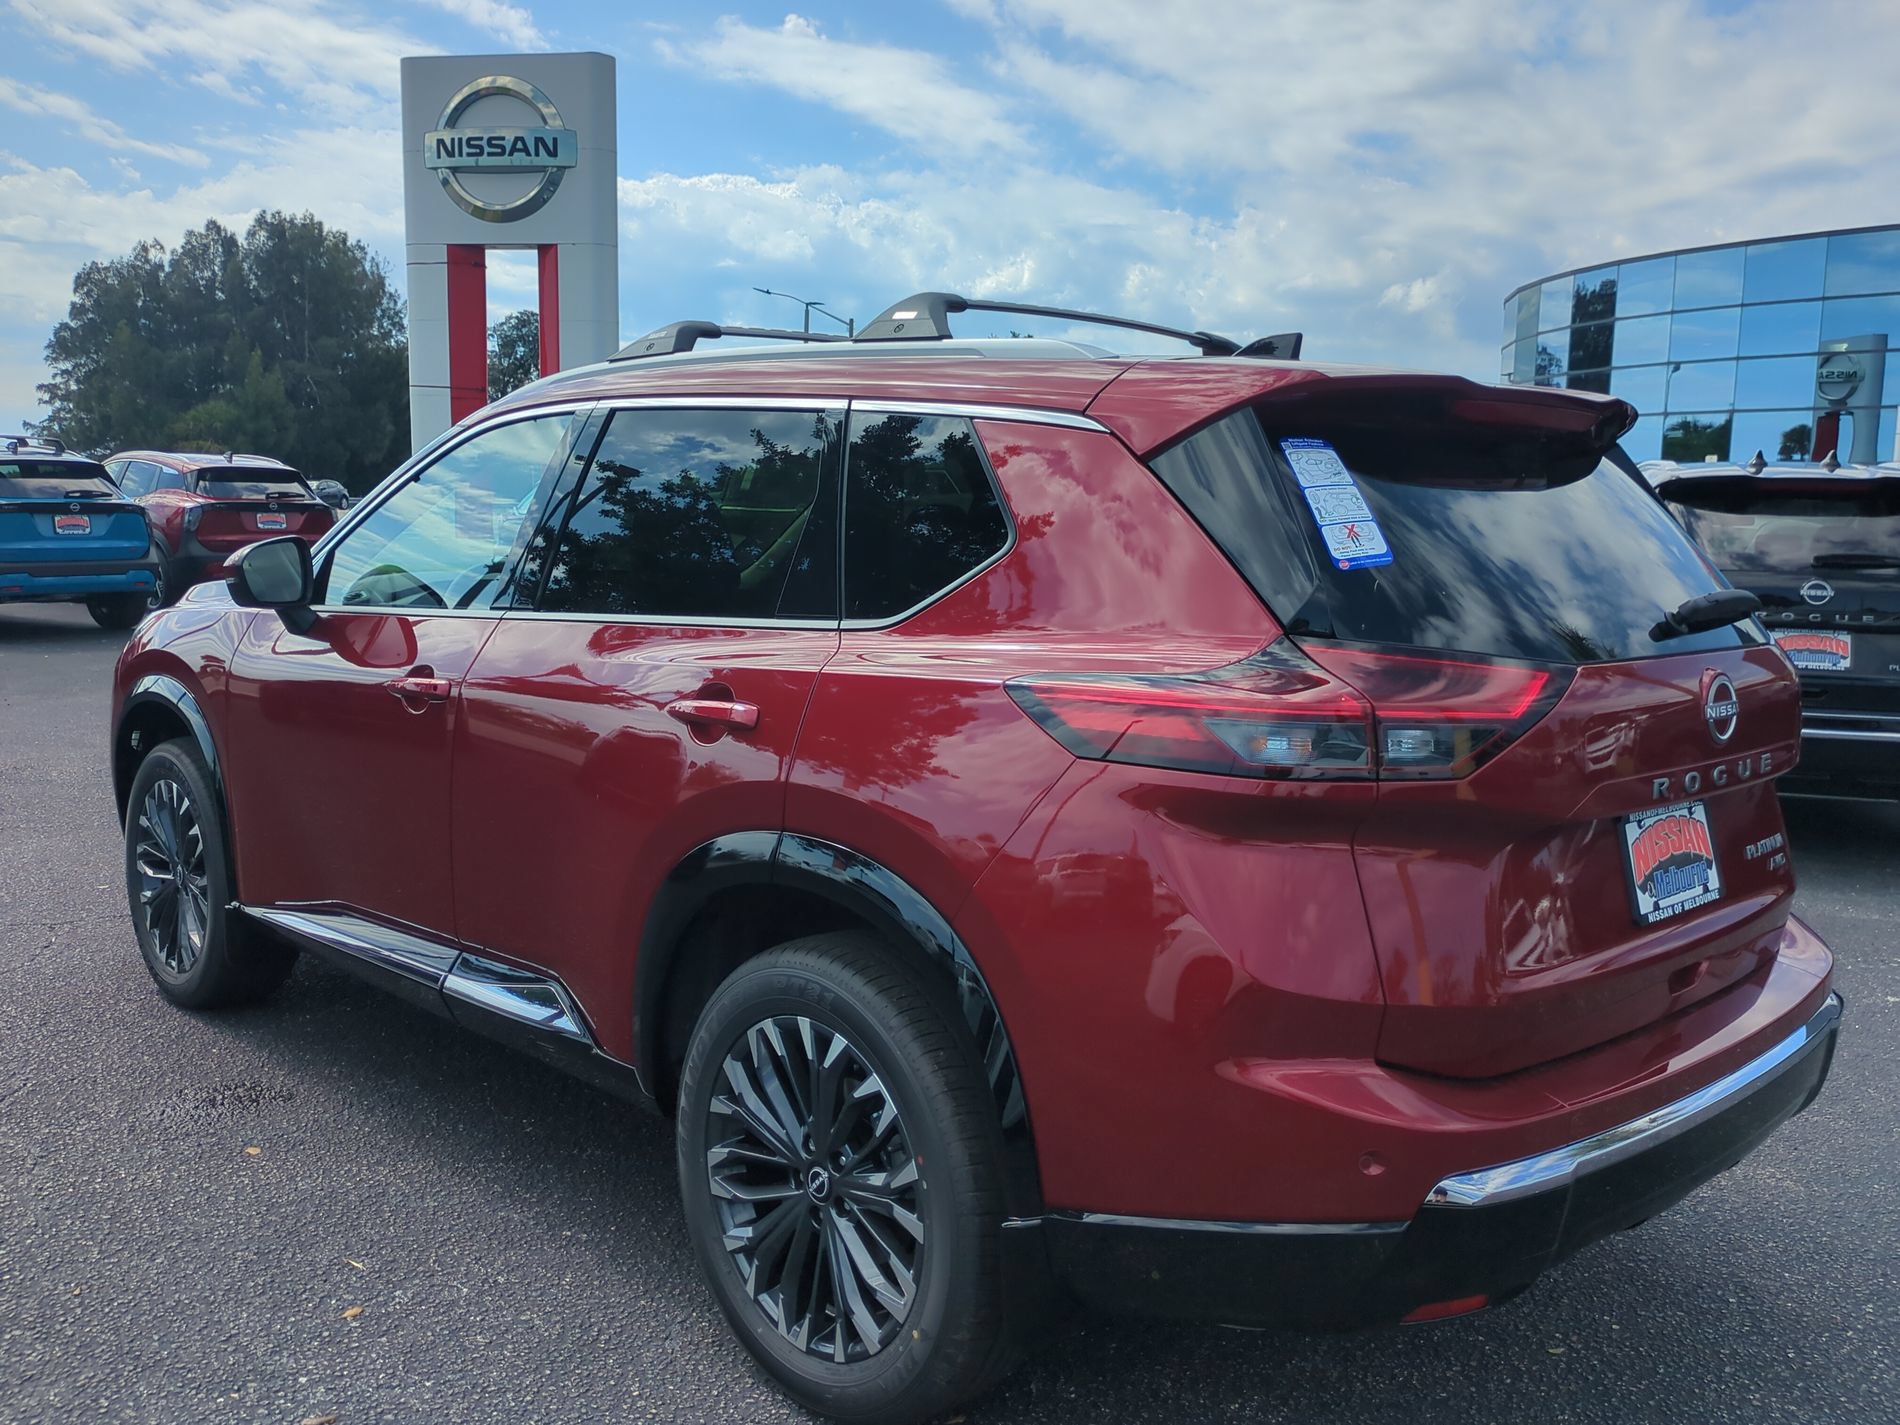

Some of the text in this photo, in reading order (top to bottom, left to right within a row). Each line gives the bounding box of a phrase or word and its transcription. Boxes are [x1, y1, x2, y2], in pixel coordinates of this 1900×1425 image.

[436, 136, 559, 159] NISSAN
[1800, 589, 1834, 597] NISSAN
[1707, 703, 1739, 718] NISSA
[1652, 753, 1772, 799] ROGUE
[1632, 816, 1713, 885] NISSAN
[1654, 861, 1710, 900] Melbourne
[1648, 890, 1720, 923] NISSAN OF MELBOURNE
